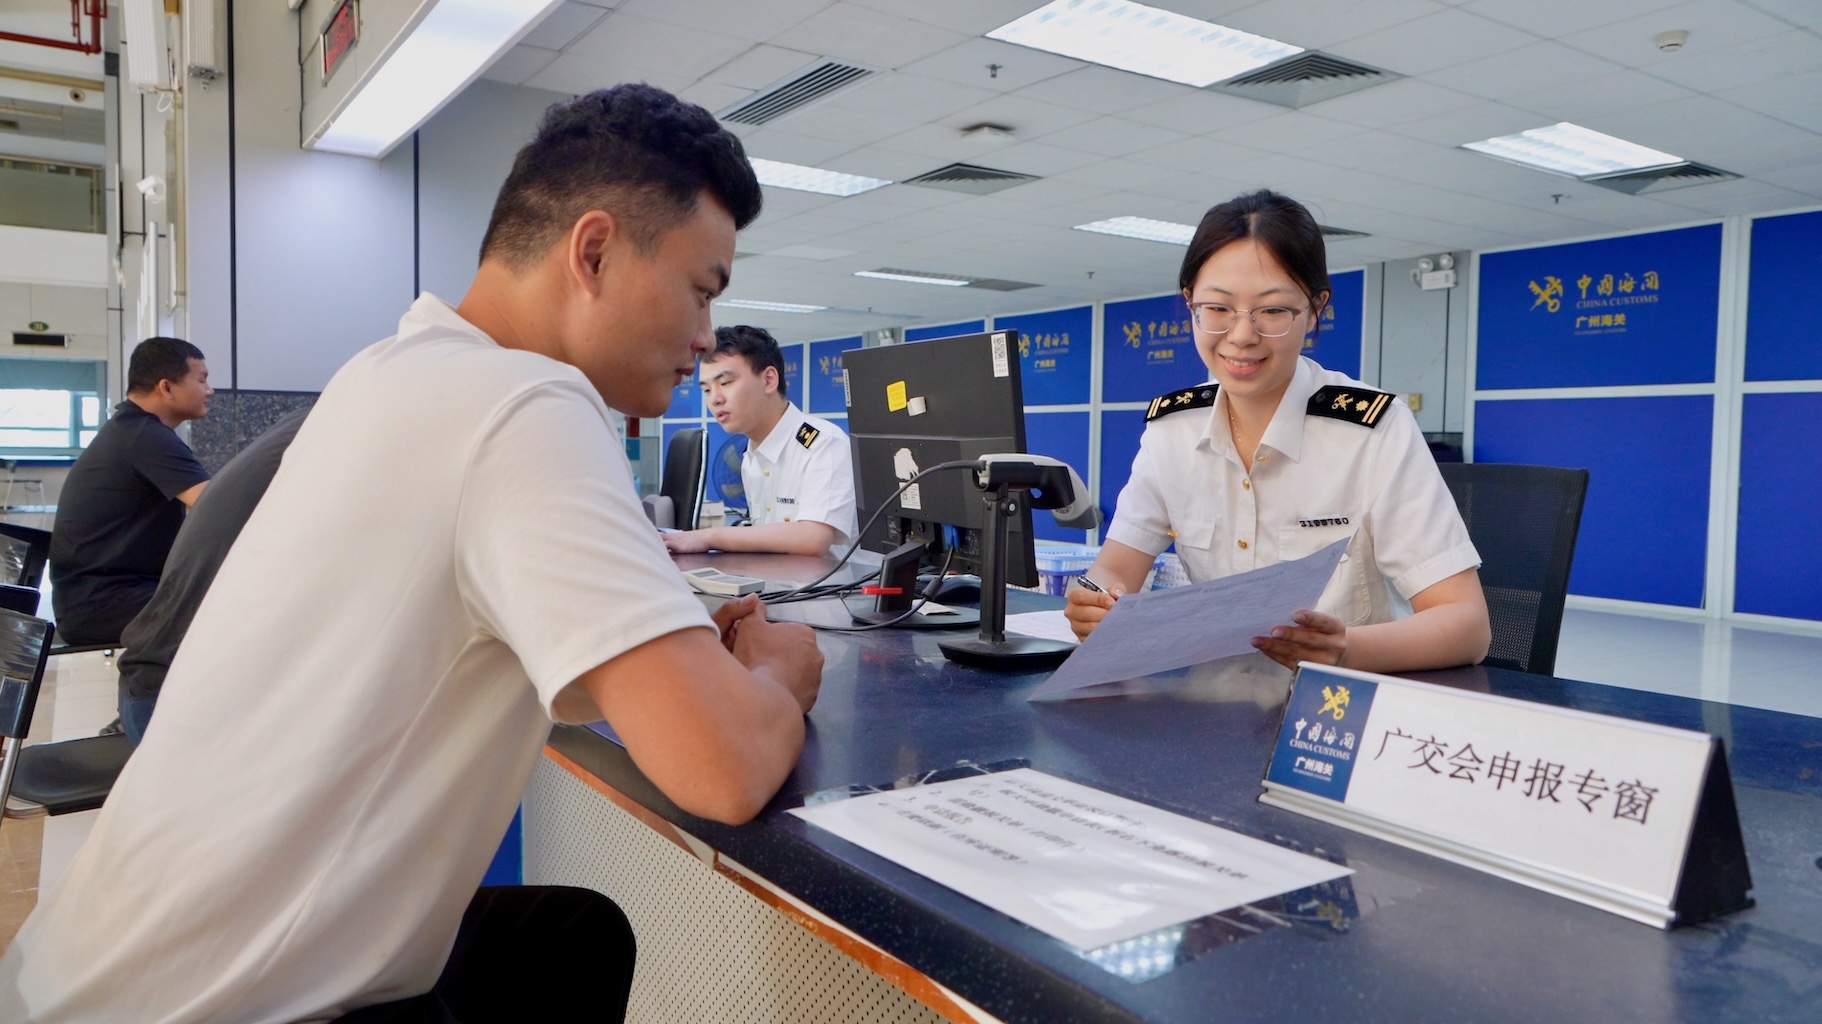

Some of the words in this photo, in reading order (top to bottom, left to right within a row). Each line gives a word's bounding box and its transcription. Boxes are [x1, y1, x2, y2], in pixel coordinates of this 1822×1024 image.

[1577, 271, 1659, 299] 中国海关
[1576, 299, 1608, 309] CHINA
[1609, 294, 1659, 306] CUSTOMS
[1575, 313, 1626, 328] 广州海关
[1295, 717, 1355, 750] 中国海关
[1289, 738, 1313, 751] CHINA
[1313, 744, 1351, 761] CUSTOMS
[1295, 756, 1334, 776] 广州海关
[1374, 727, 1659, 825] 广交会申报专窗
